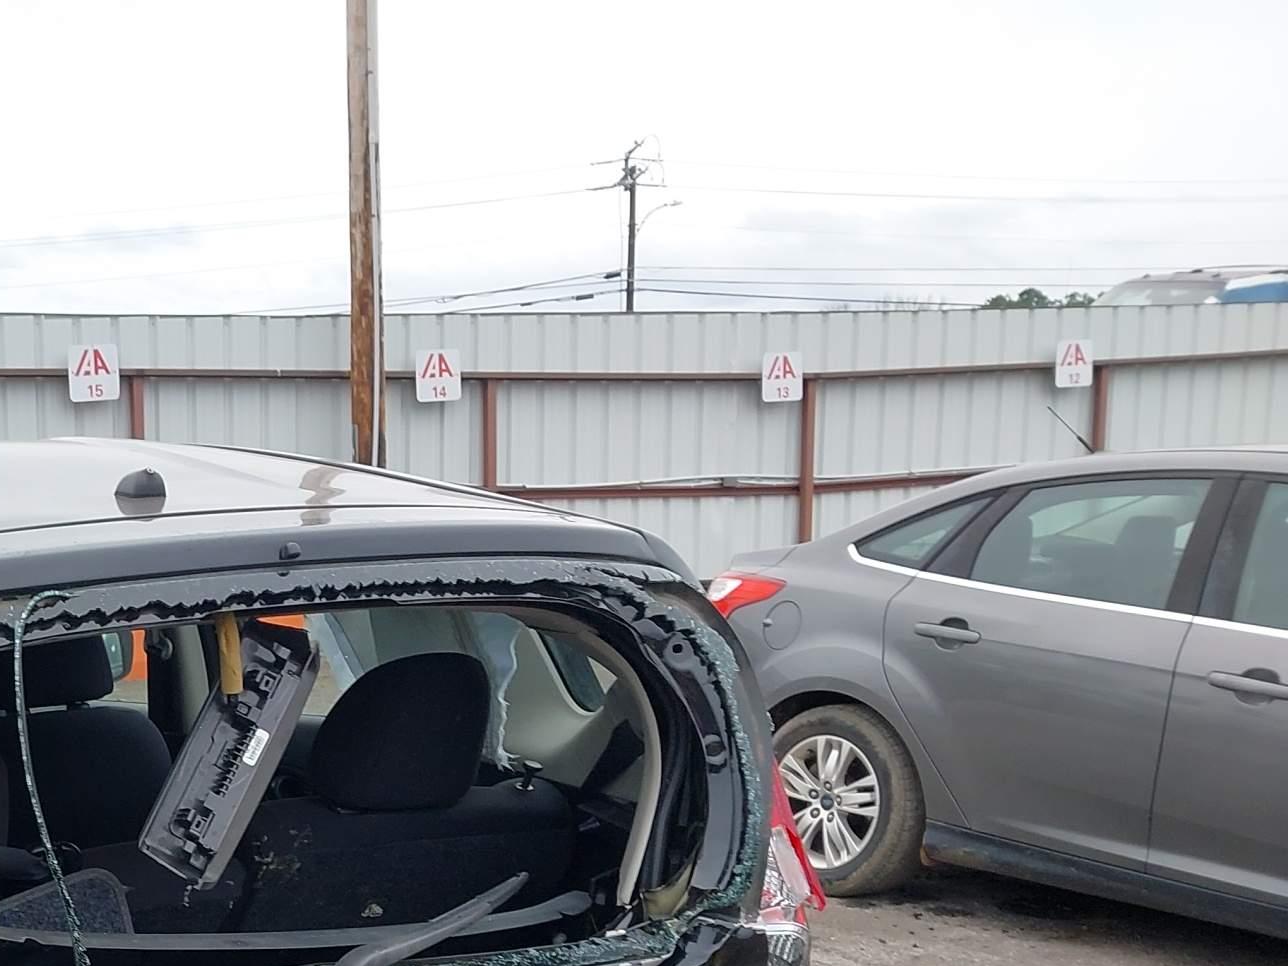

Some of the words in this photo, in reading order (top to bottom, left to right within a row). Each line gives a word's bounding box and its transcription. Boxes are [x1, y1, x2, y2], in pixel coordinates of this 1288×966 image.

[87, 384, 104, 398] 15
[432, 385, 447, 399] 14
[776, 386, 790, 399] 13
